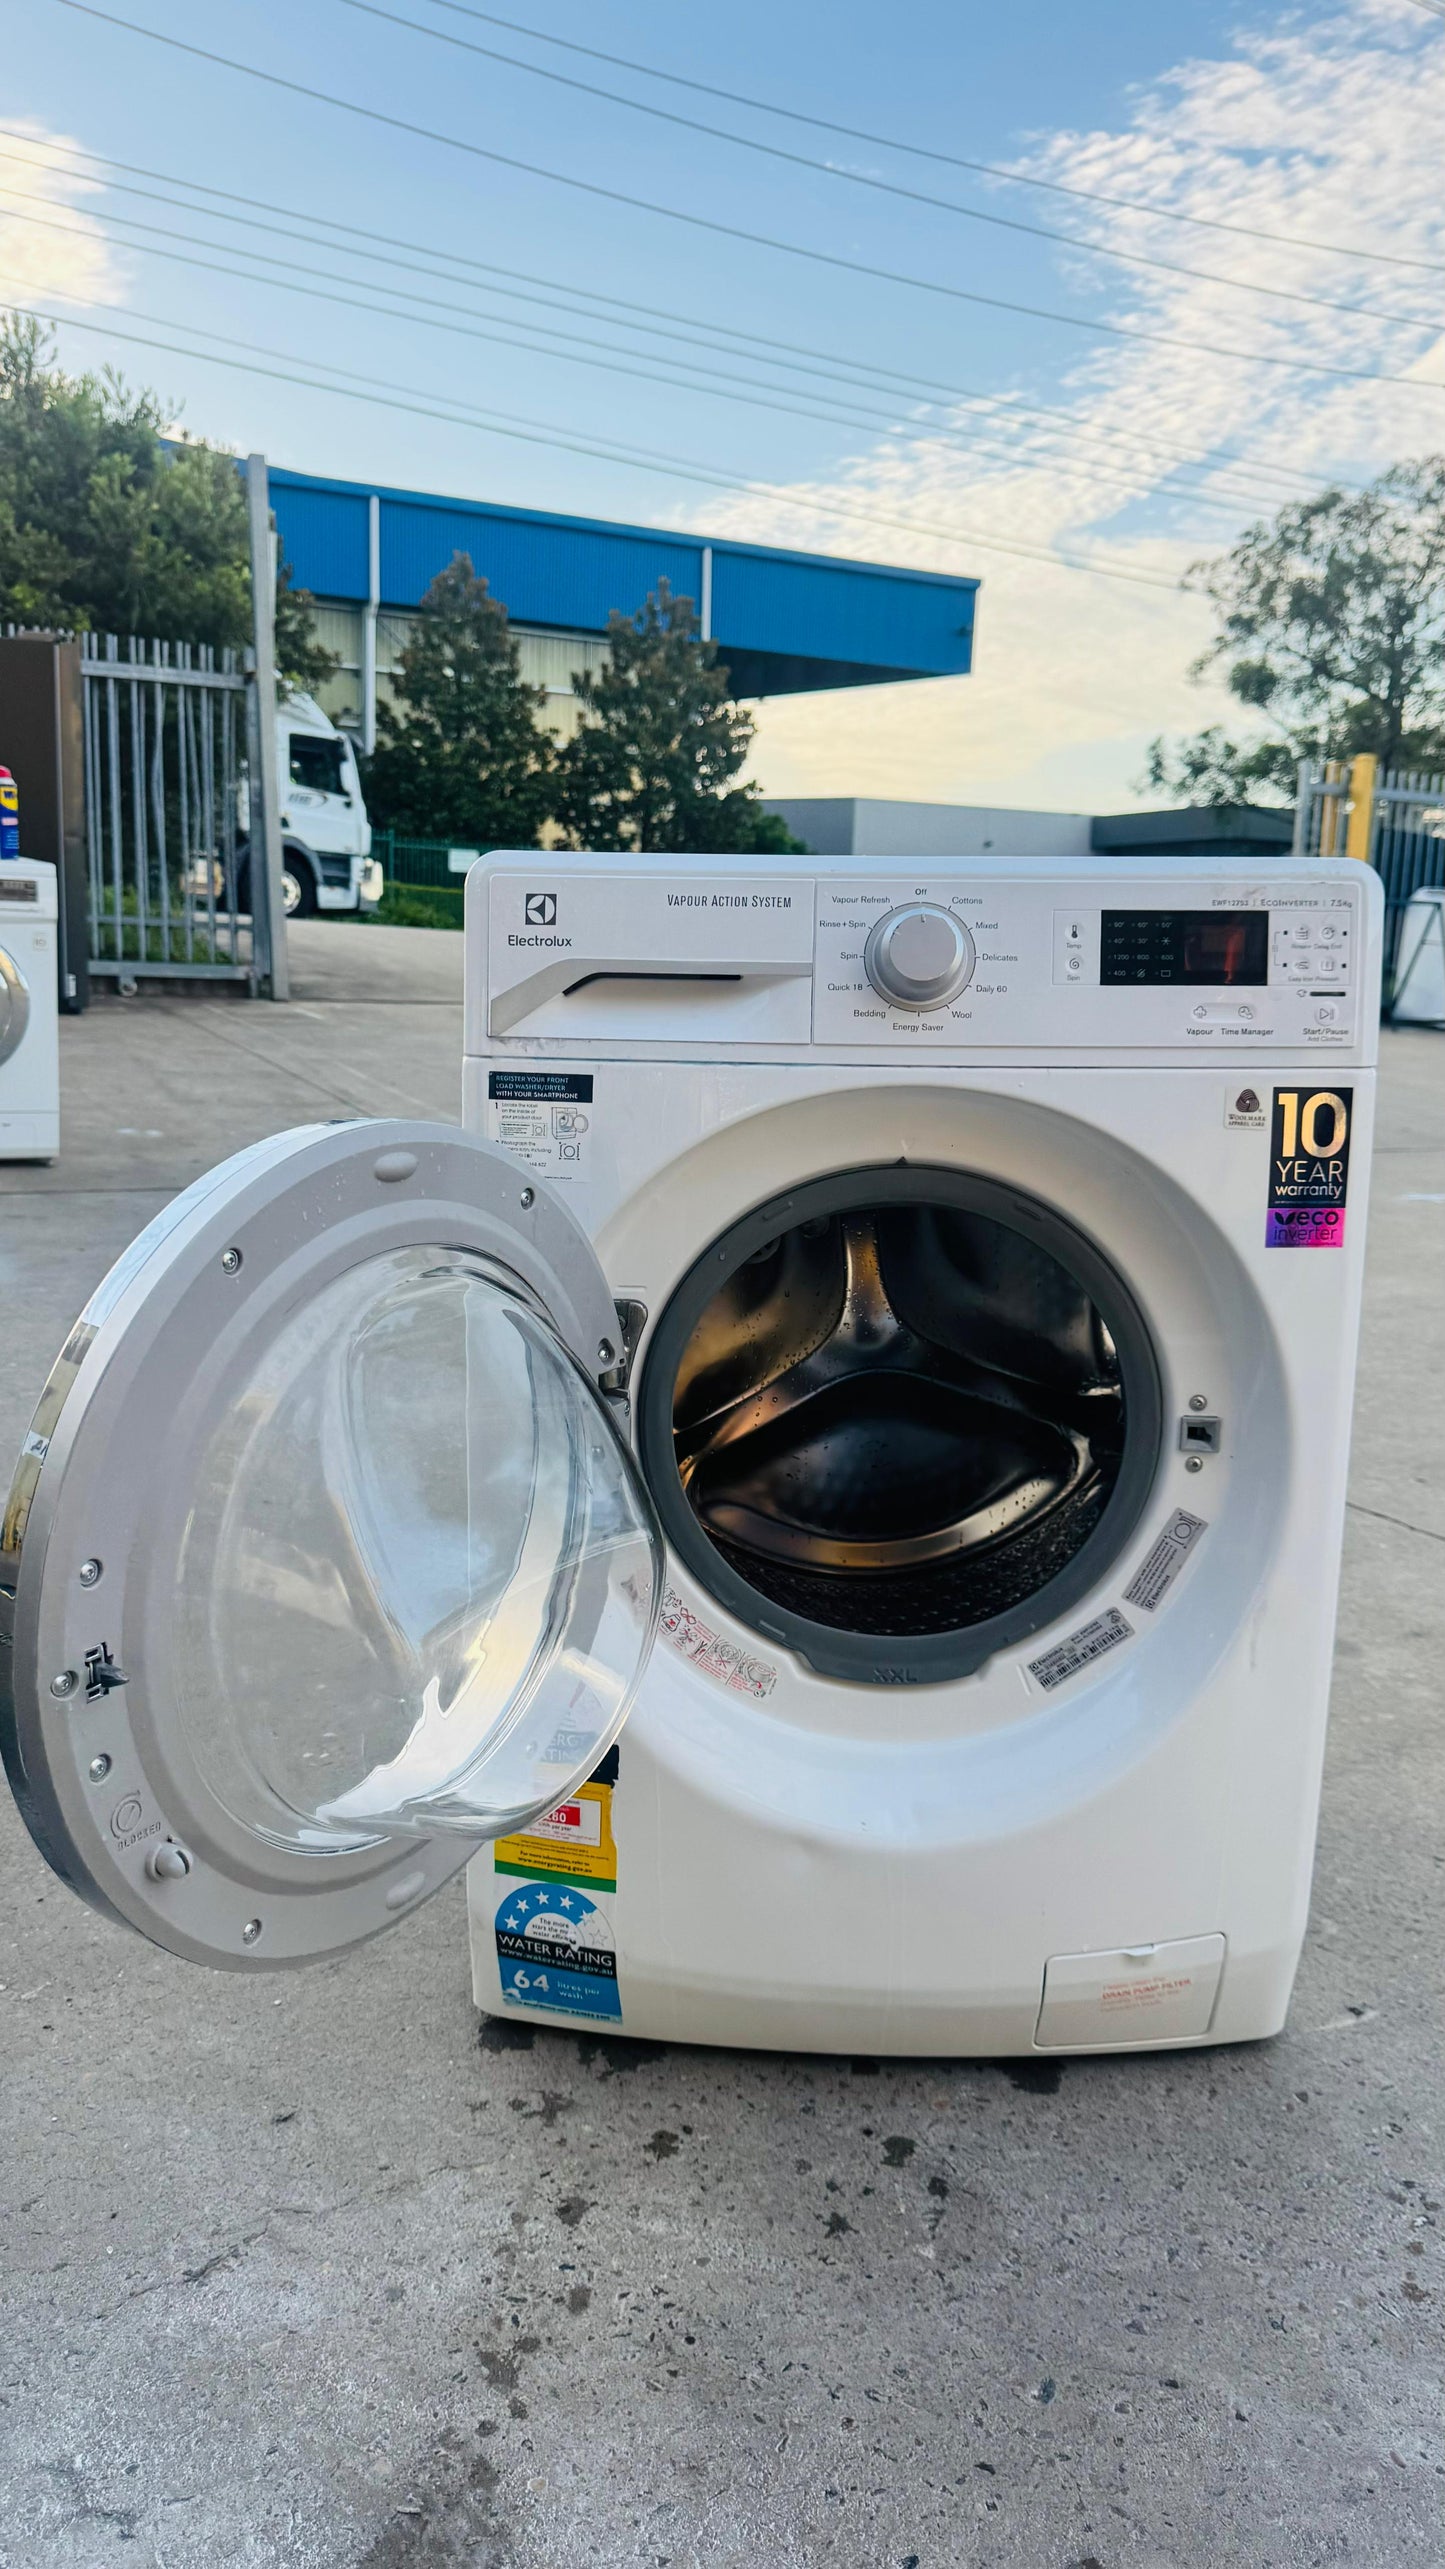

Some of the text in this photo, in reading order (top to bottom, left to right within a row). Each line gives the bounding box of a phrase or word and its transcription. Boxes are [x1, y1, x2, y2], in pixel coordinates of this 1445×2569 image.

[914, 888, 928, 896] Off
[667, 894, 792, 908] VAPOUR ACTION SYSTEM
[832, 896, 890, 905] Vapour Refresh
[952, 897, 983, 905] Cottons
[848, 920, 866, 930] Spin
[976, 922, 998, 930] Mixed
[508, 934, 572, 948] Electrolux
[840, 952, 858, 962] Spin
[982, 954, 1018, 962] Delicates
[827, 984, 850, 992] Quick
[976, 985, 995, 994] Daily
[853, 1010, 886, 1019] Bedding
[951, 1011, 972, 1019] Wool
[892, 1024, 944, 1033] Energy Saver
[1186, 1028, 1214, 1036] Vapour
[1220, 1028, 1274, 1037] Time Manager
[1302, 1028, 1349, 1036] Start/Pause
[533, 1092, 578, 1100] SMARTPHONE
[1278, 1092, 1347, 1158] 10
[1276, 1160, 1343, 1182] YEAR
[1275, 1182, 1343, 1199] warranty
[1296, 1211, 1339, 1226] eco
[1274, 1226, 1338, 1241] inverter
[498, 1934, 613, 1967] WATER RATING
[500, 1948, 614, 1976] www.waterrating.gov.au
[514, 1969, 550, 1993] 64
